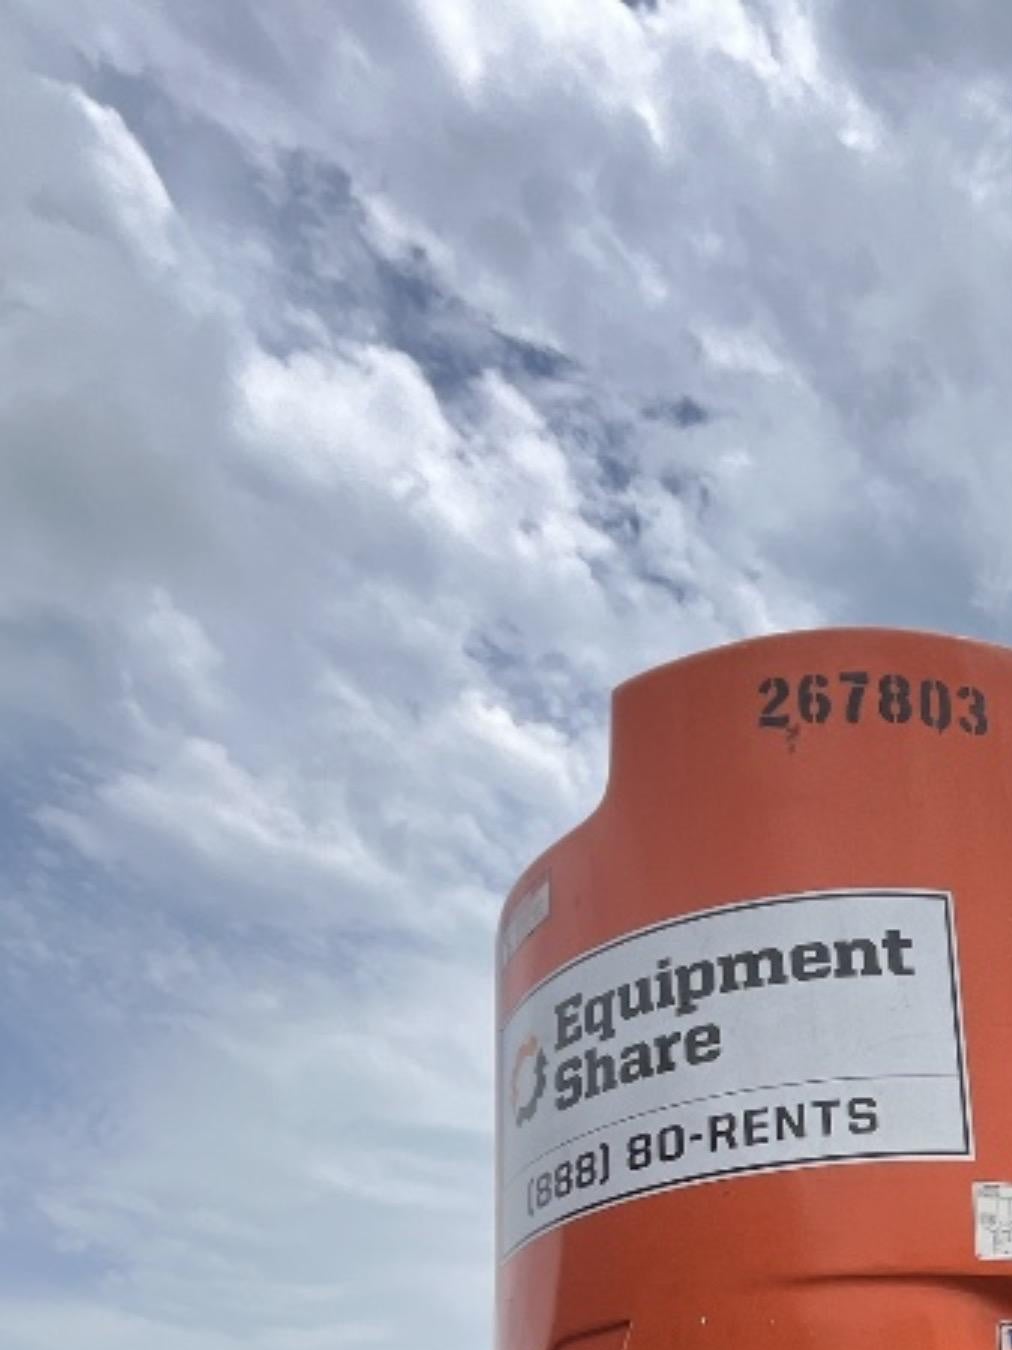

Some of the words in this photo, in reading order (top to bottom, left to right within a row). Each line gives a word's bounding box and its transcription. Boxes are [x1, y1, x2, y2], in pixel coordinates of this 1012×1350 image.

[758, 672, 989, 735] 267803
[553, 928, 916, 1052] Equipment
[553, 1022, 722, 1111] Share
[526, 1142, 611, 1216] (888)
[626, 1097, 879, 1171] 80-RENTS
